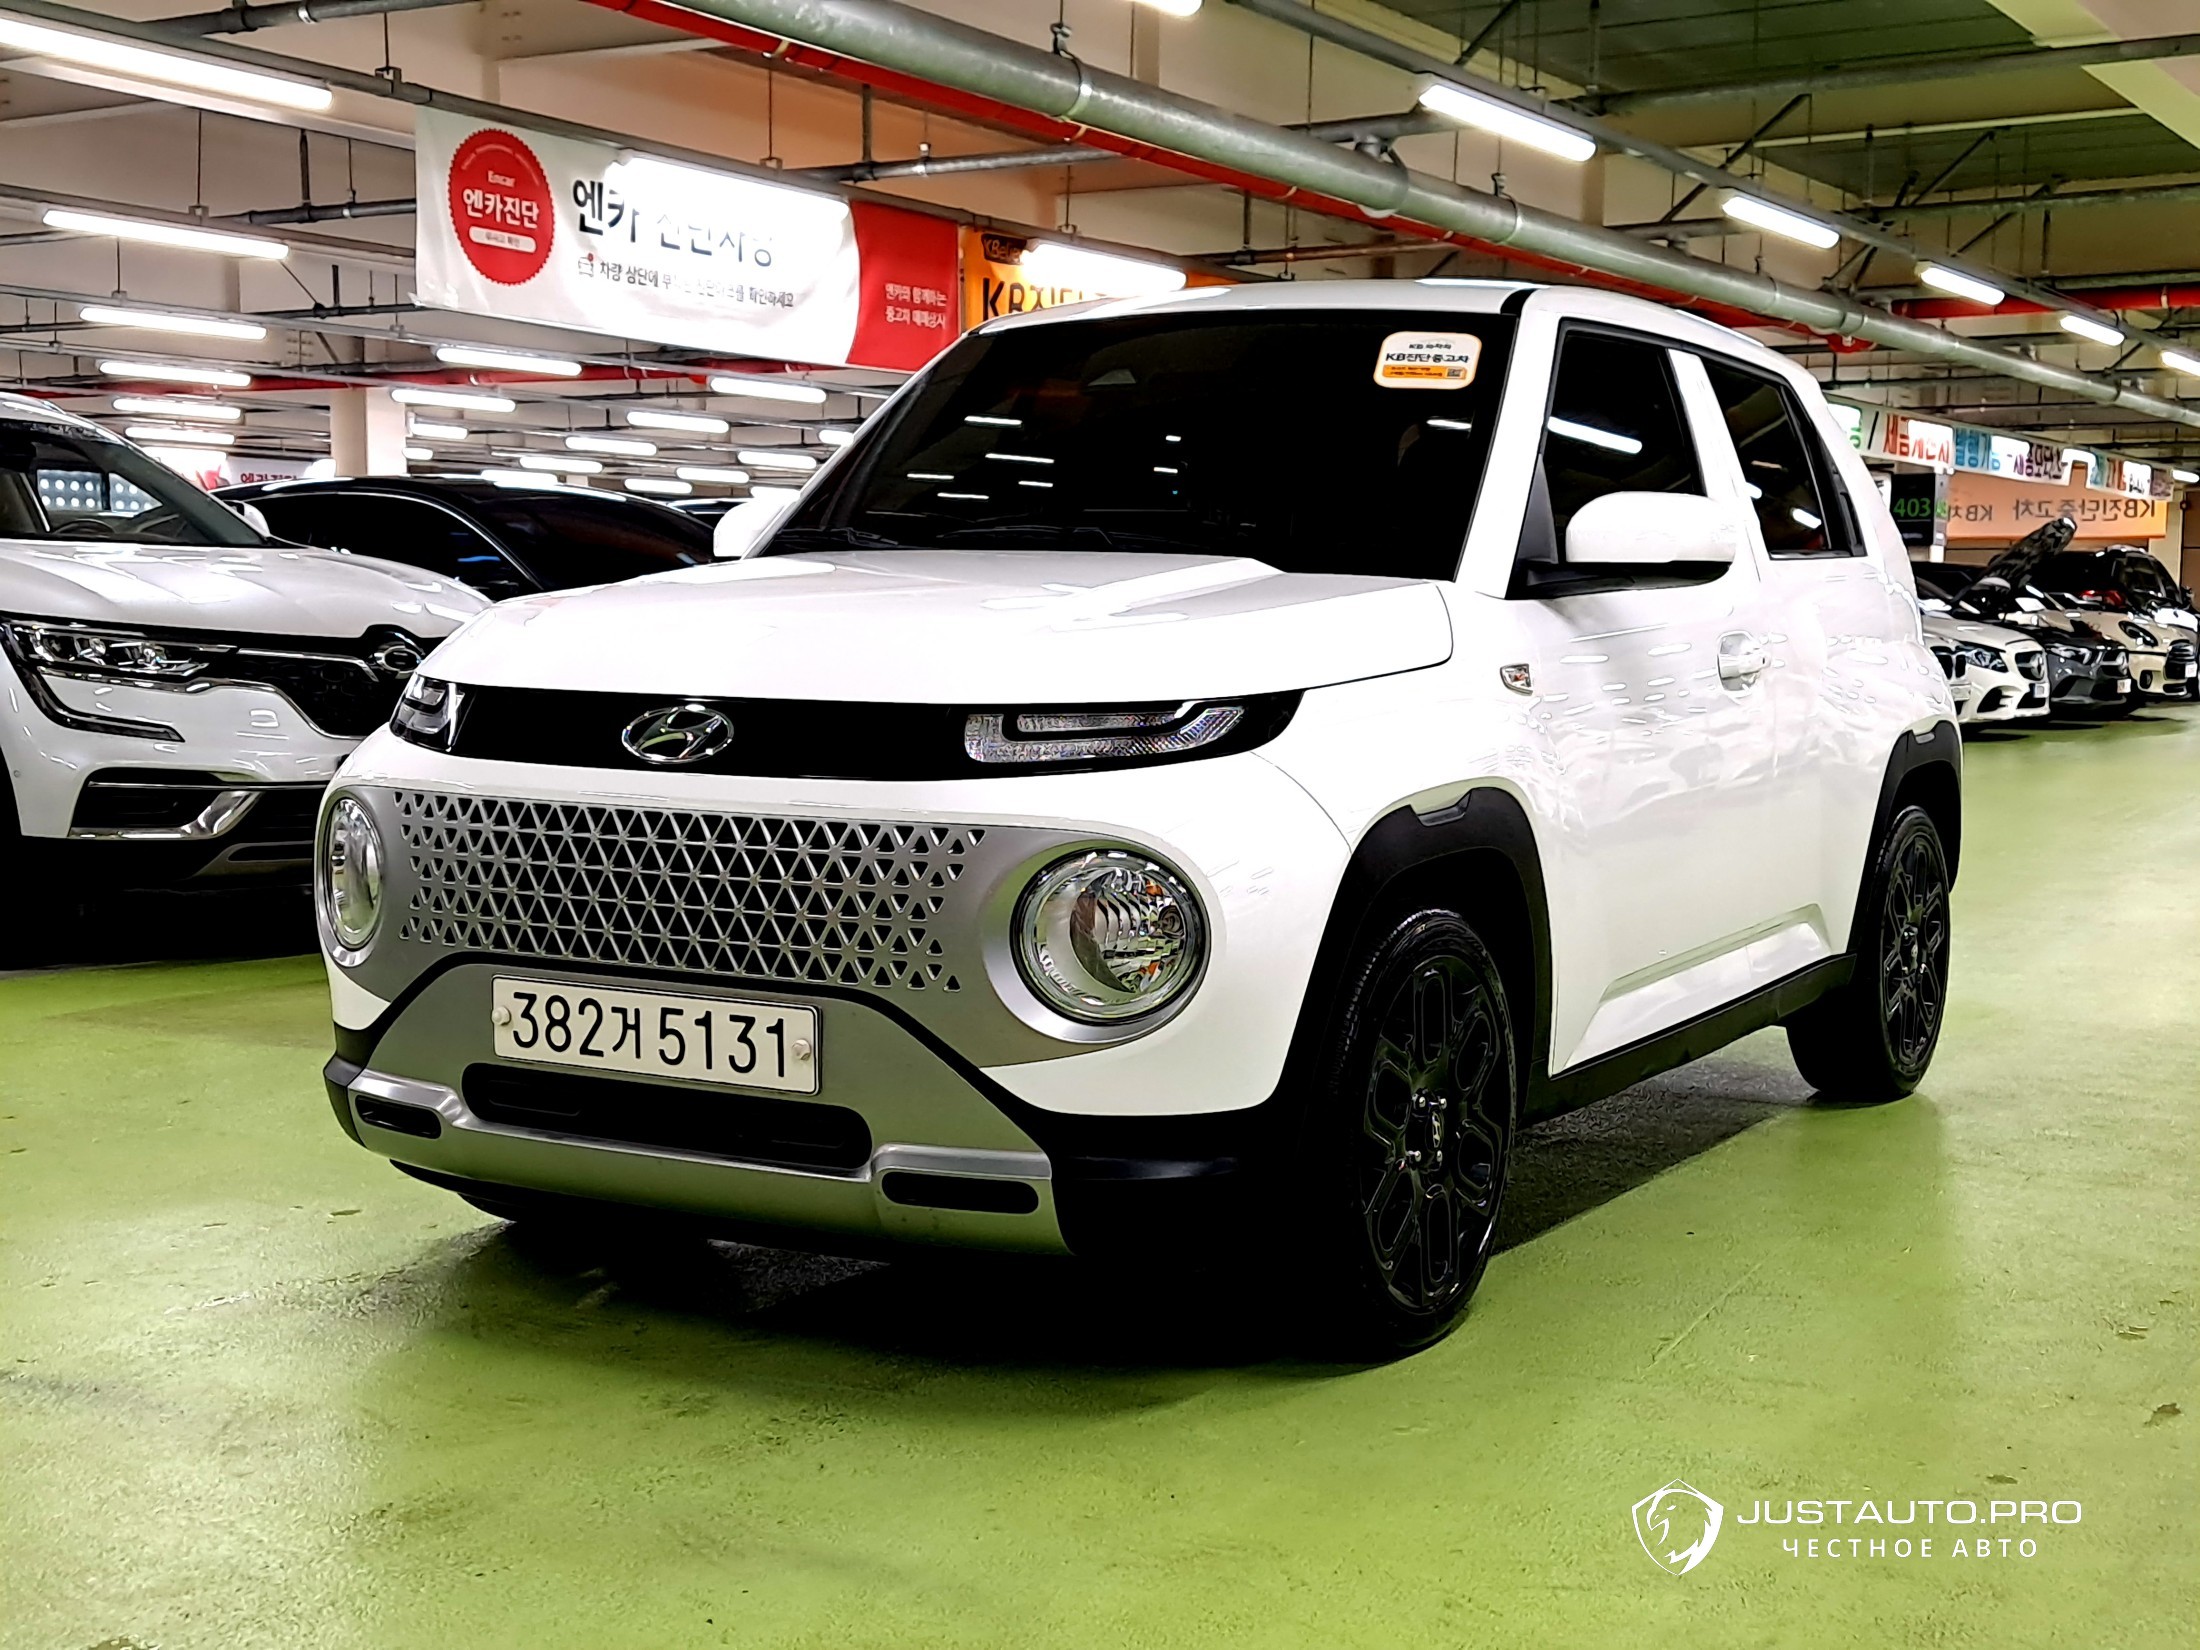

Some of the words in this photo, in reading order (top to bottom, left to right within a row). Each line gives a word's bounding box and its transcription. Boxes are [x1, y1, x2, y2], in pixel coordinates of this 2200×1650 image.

[462, 188, 540, 229] 엔카진단
[600, 261, 622, 282] 차량
[626, 266, 659, 287] 상단에
[1893, 498, 1932, 517] 403
[512, 991, 642, 1060] 382거
[657, 1006, 786, 1078] 5131
